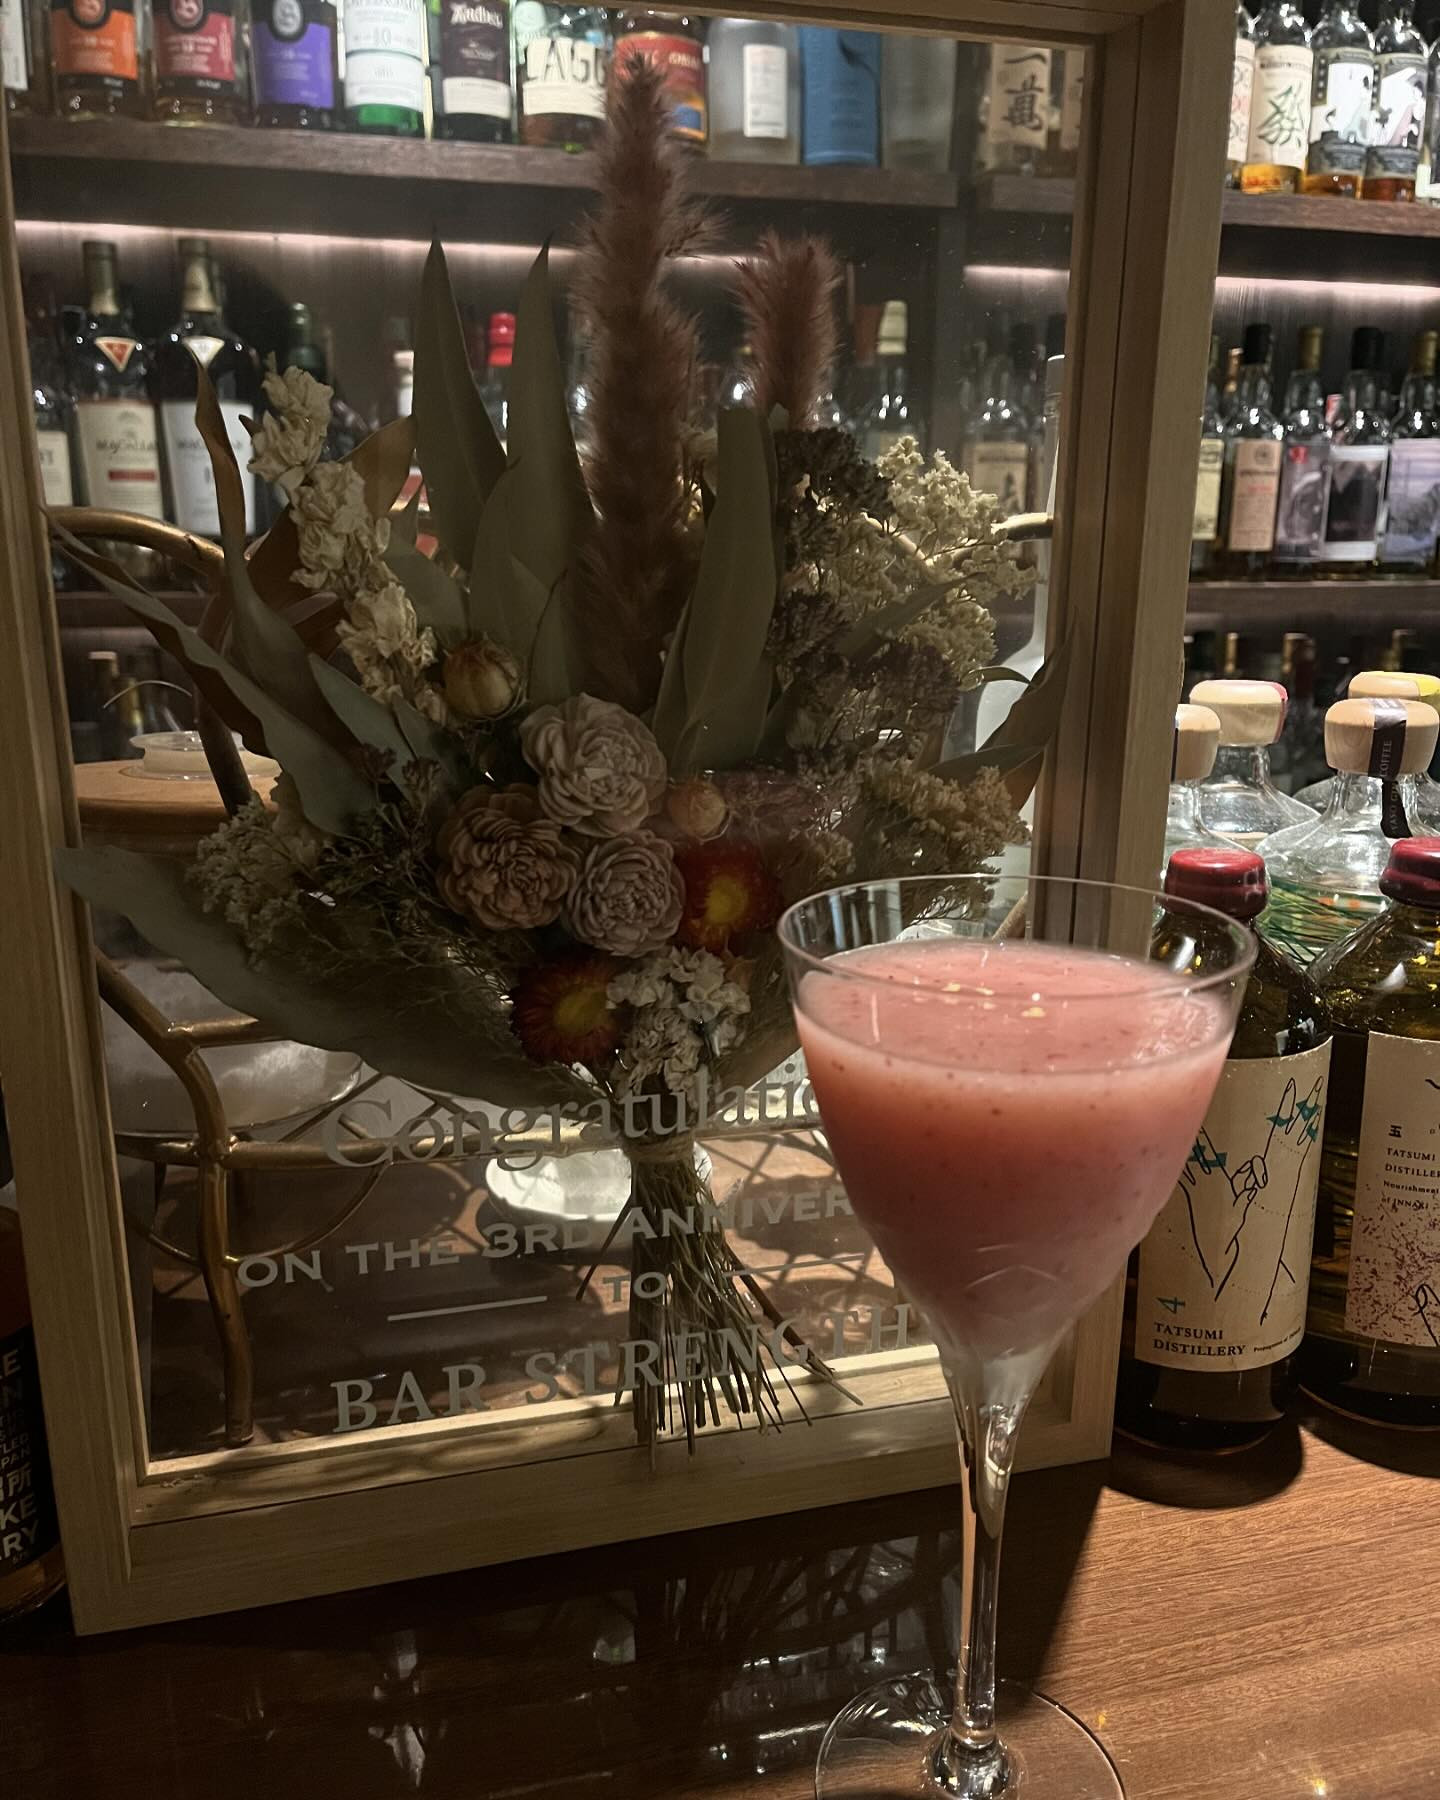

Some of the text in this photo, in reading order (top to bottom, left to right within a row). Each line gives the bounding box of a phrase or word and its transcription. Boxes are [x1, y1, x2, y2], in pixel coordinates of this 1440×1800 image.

[321, 1061, 821, 1172] Congratulati
[1386, 1147, 1436, 1162] TATSUMI
[1384, 1163, 1440, 1178] DISTILLE
[237, 1183, 855, 1288] ON THE 3RD ANNIVER
[602, 1271, 667, 1303] TO
[1154, 1321, 1224, 1340] TATSUMI
[1153, 1338, 1246, 1357] DISTILLERY
[329, 1302, 913, 1433] BAR STRENGTH
